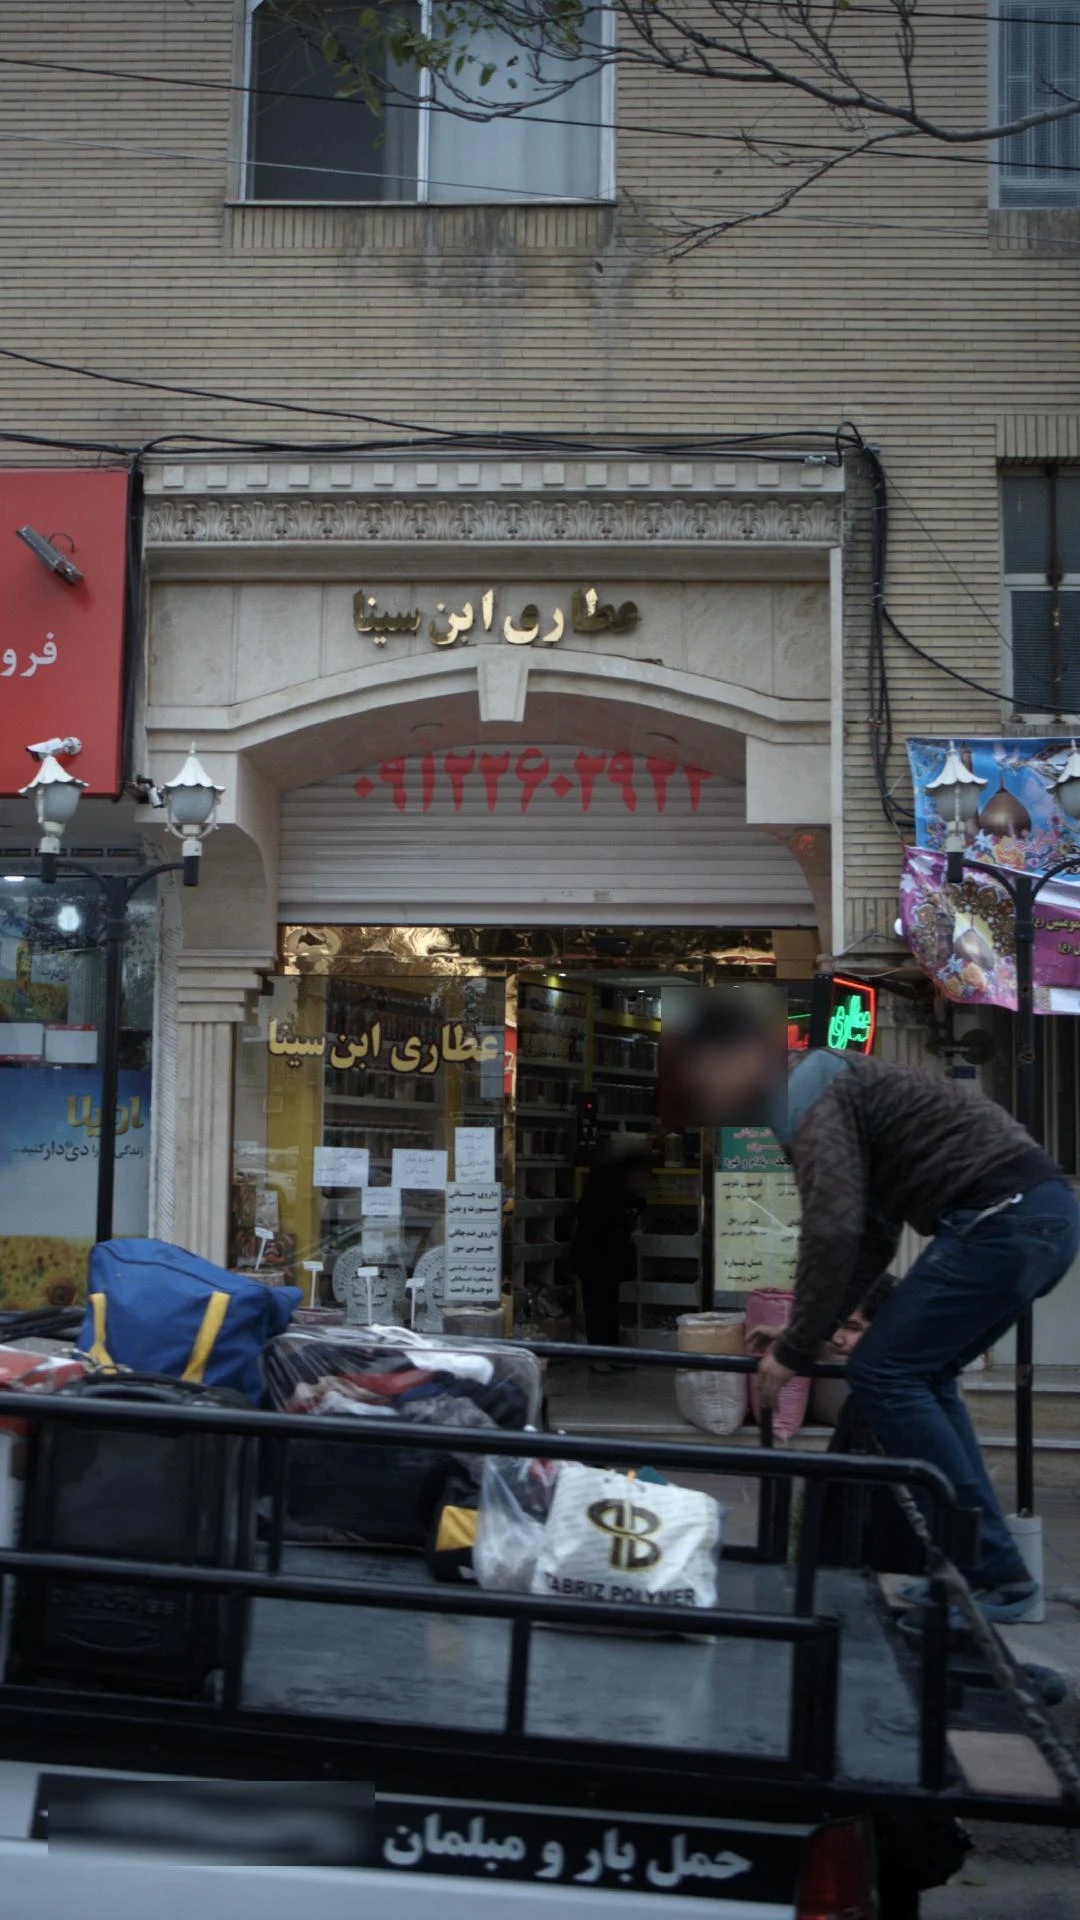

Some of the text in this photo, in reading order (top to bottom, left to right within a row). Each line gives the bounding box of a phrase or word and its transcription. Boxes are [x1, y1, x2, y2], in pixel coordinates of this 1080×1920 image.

[353, 587, 641, 647] عطاری ابن سینا
[268, 1018, 499, 1073] عطاری ابن سینا
[544, 1572, 605, 1599] TABRIZ
[382, 1812, 753, 1887] حمل بار و مبلمان
